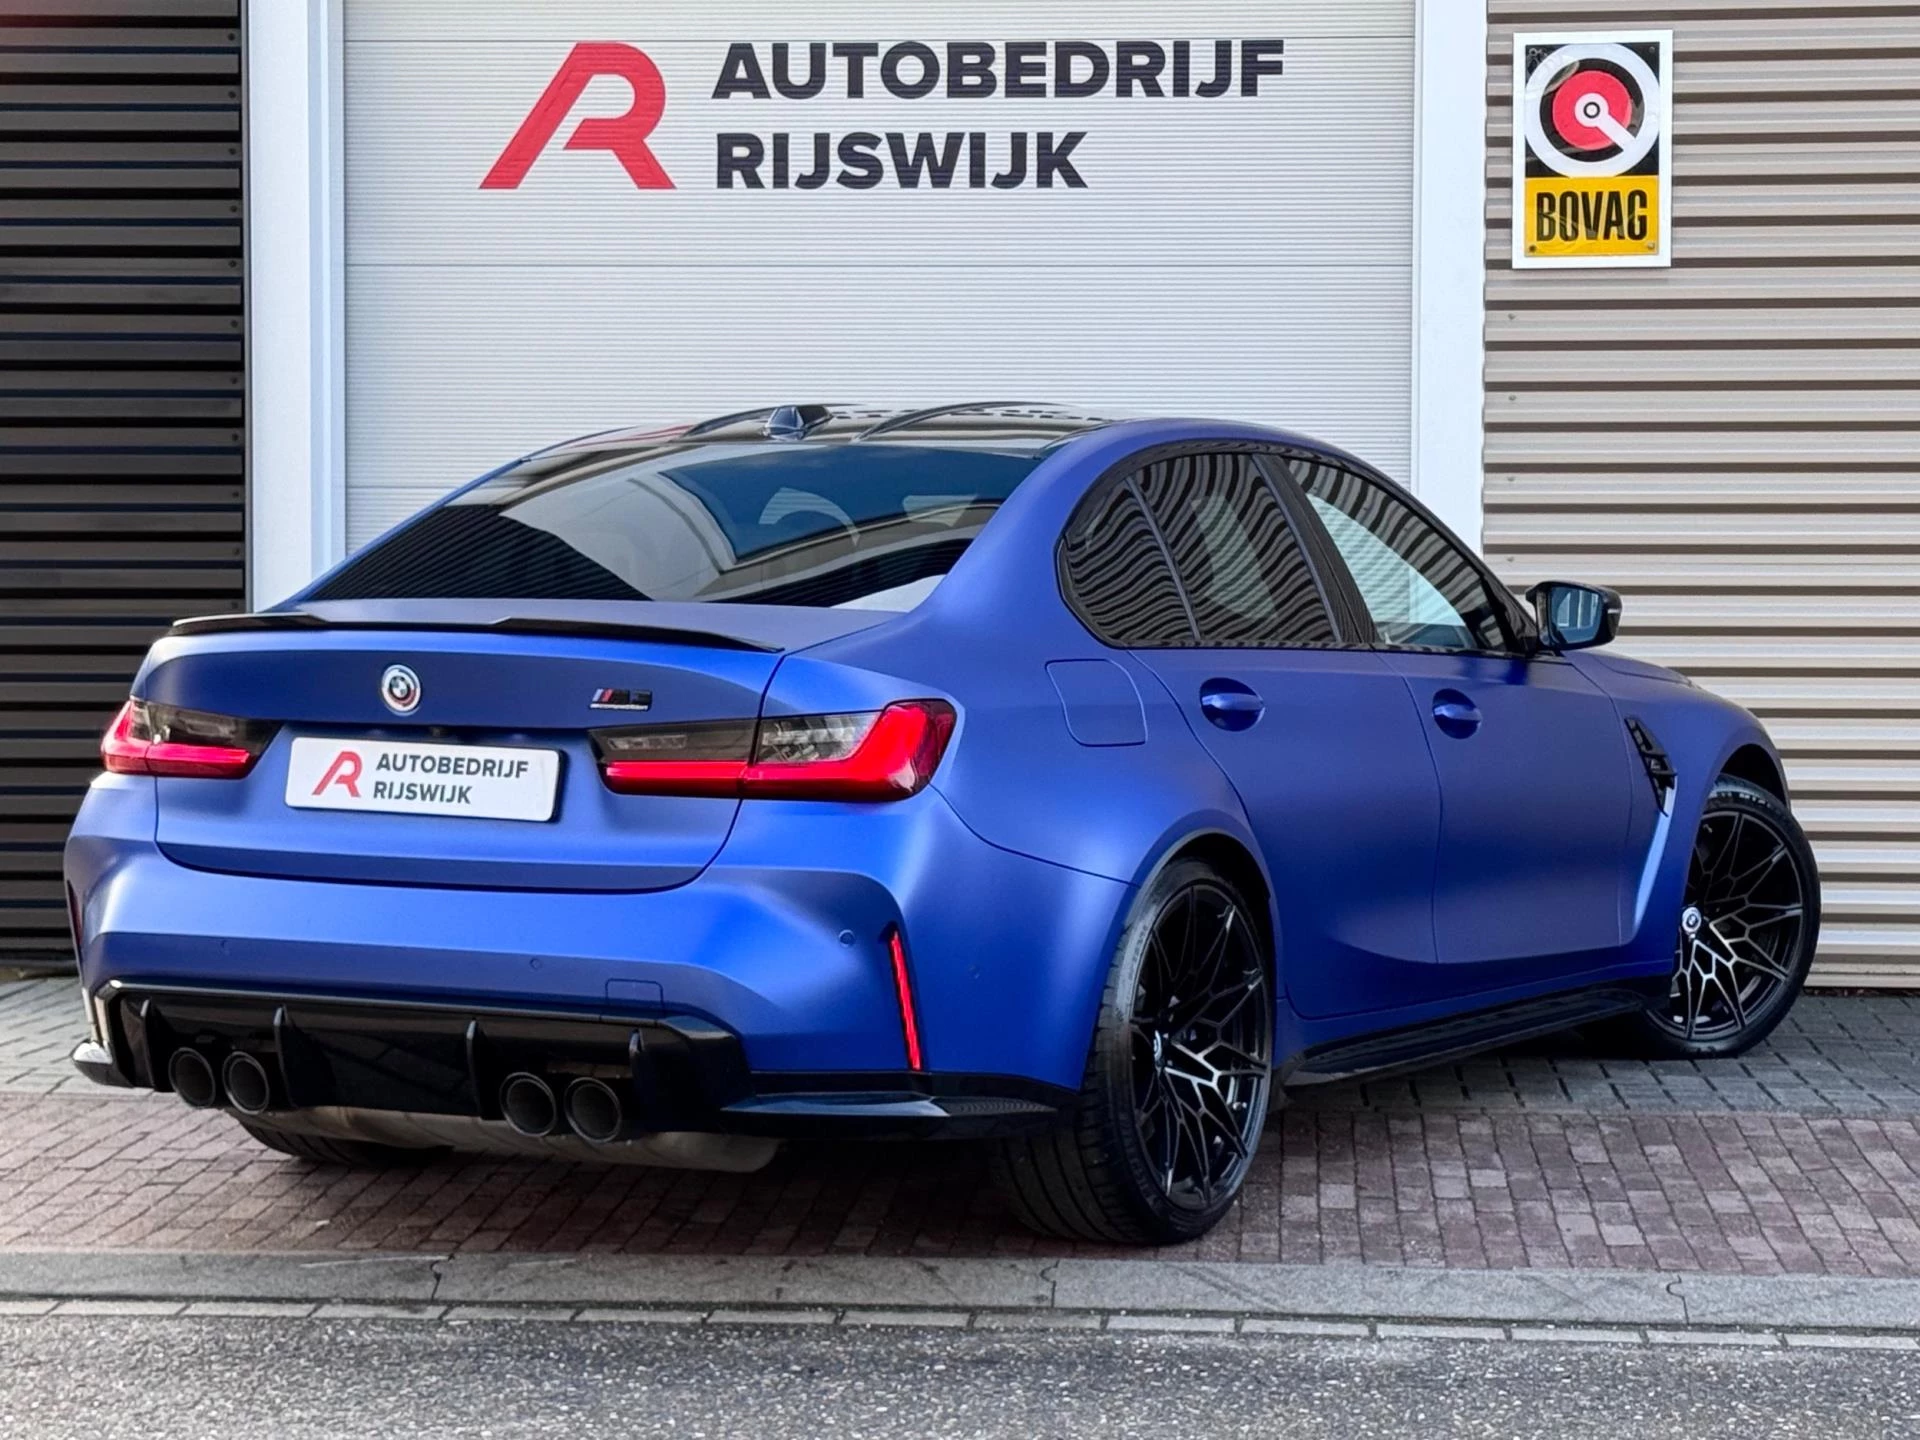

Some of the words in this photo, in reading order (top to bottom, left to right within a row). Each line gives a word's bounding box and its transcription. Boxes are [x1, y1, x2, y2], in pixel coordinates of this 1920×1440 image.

[711, 39, 1284, 100] AUTOBEDRIJF
[716, 131, 1088, 190] RIJSWIJK
[1536, 189, 1648, 242] BOVAG
[373, 780, 472, 804] RIJSWIJK
[375, 752, 529, 779] AUTOBEDRIJF
